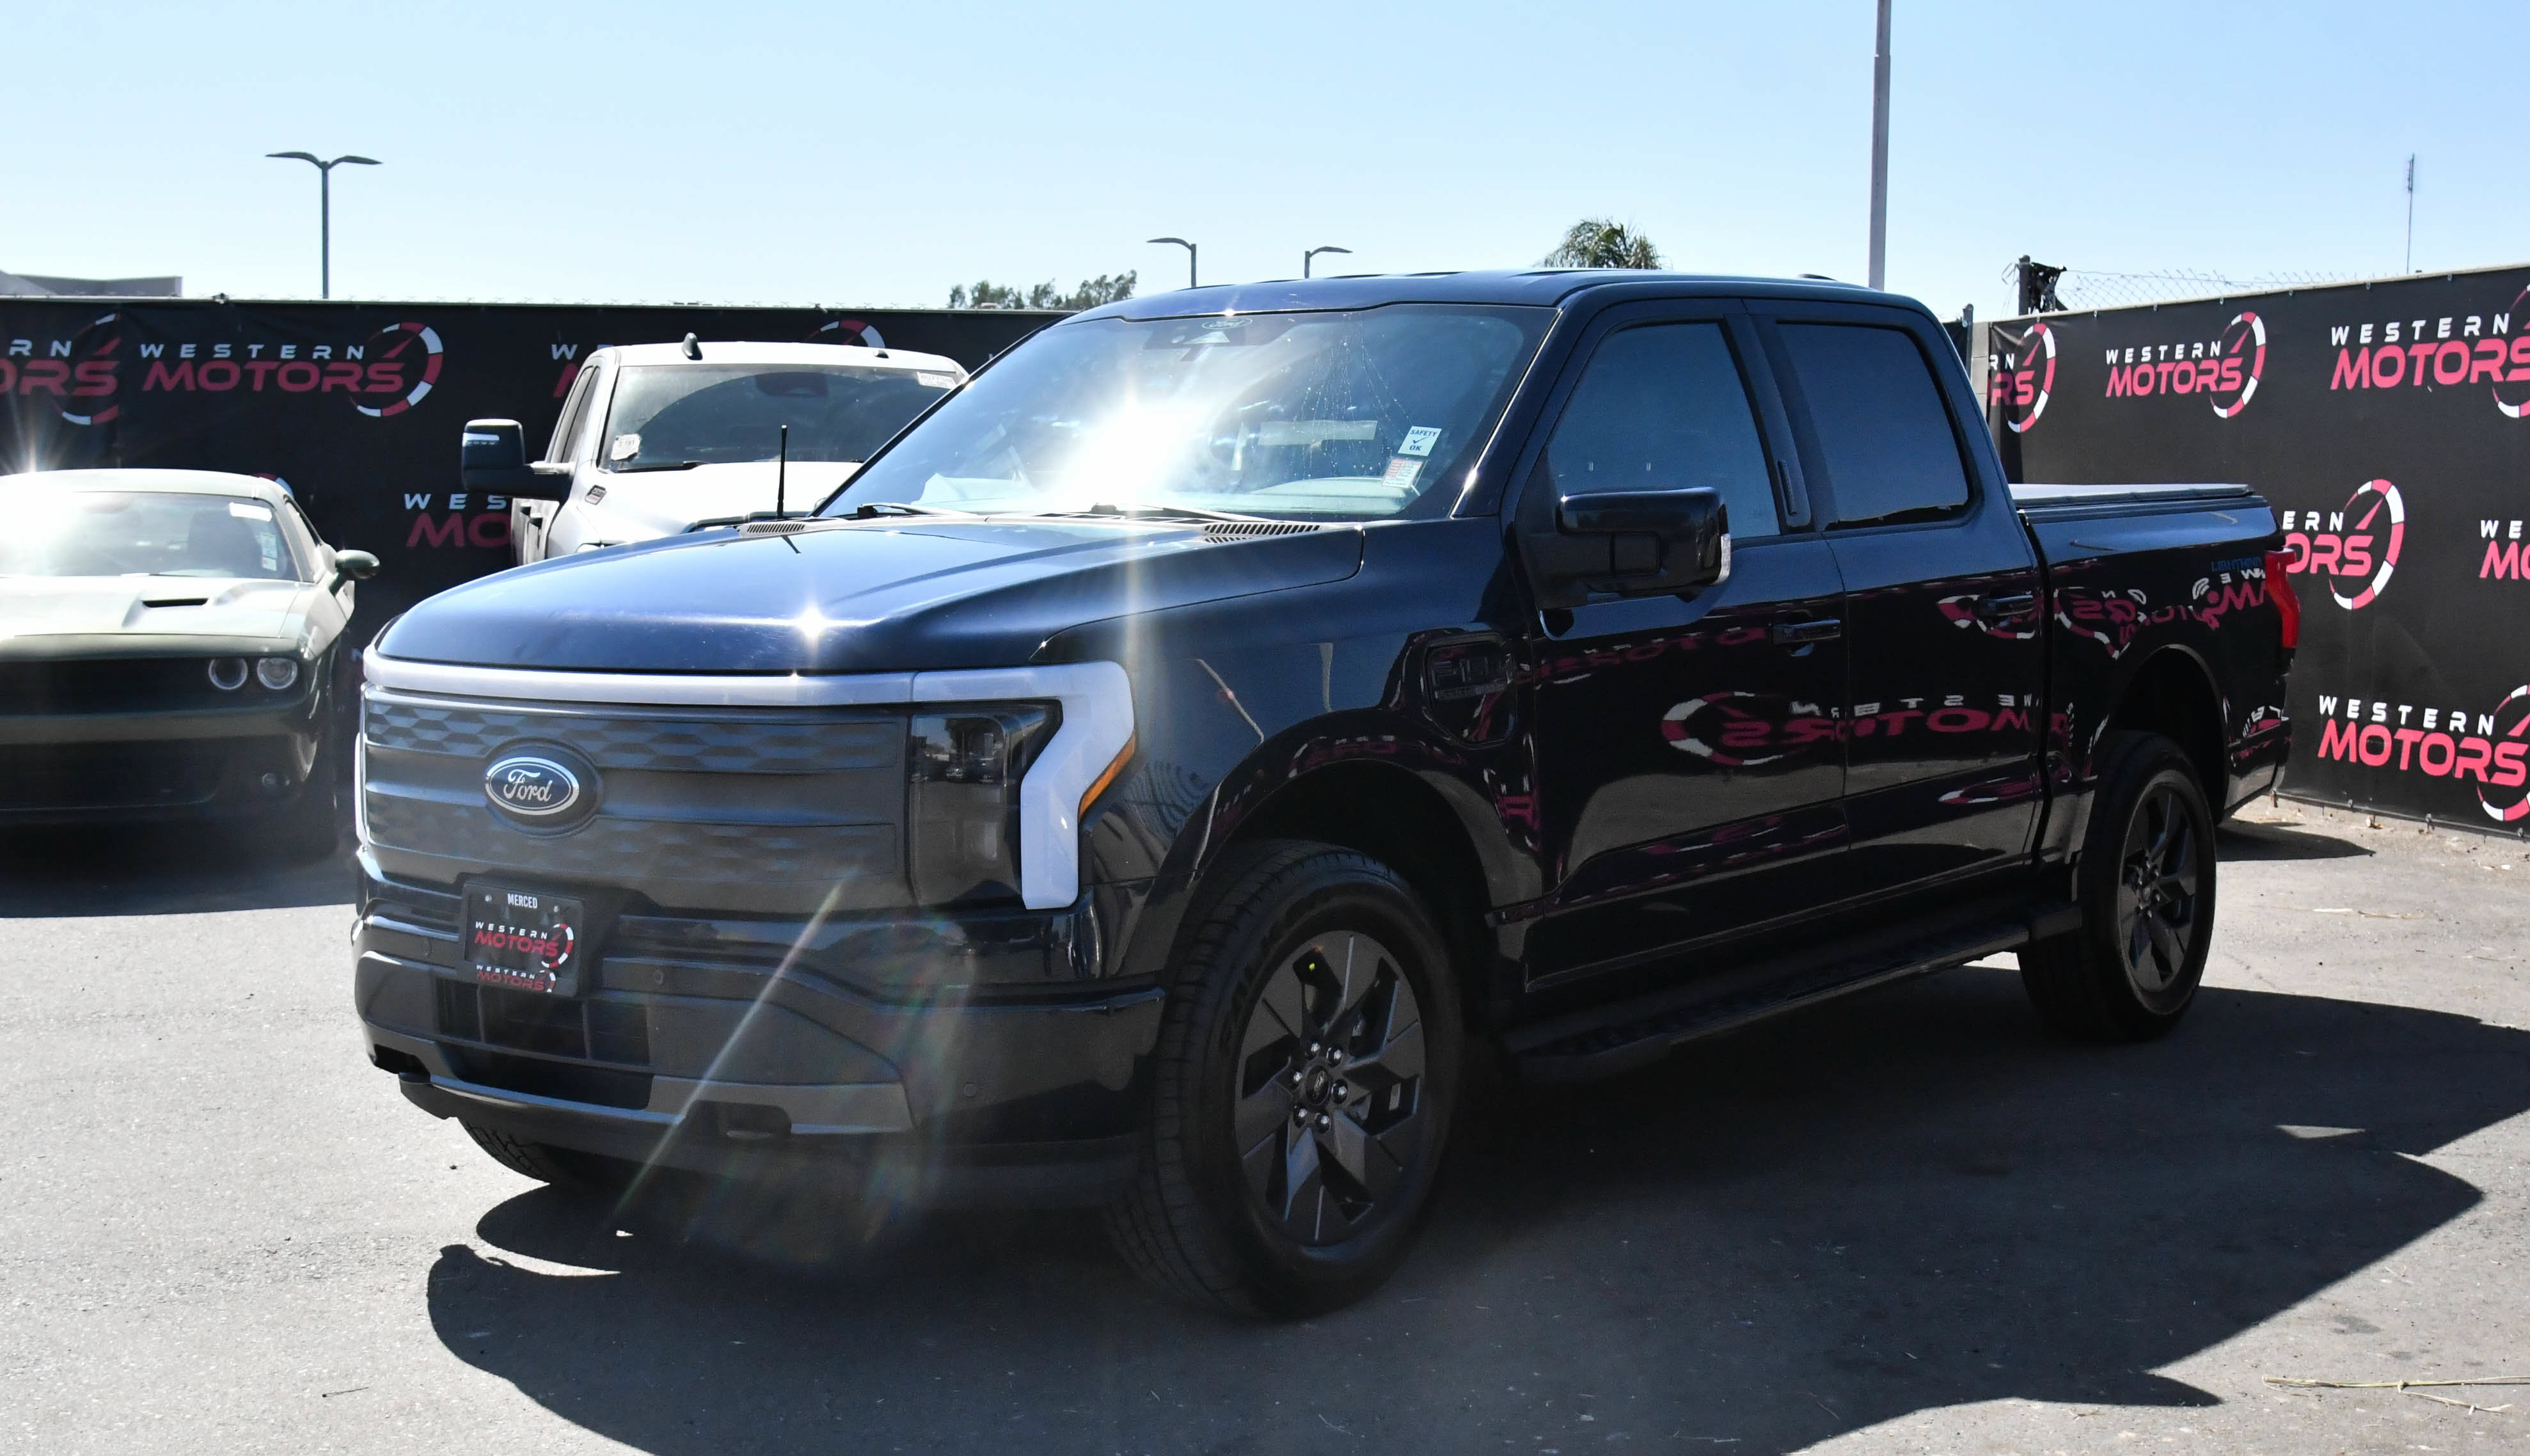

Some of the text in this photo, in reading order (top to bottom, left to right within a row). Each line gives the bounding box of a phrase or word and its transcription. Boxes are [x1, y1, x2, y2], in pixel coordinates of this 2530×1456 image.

[2330, 313, 2510, 347] WESTERN
[9, 339, 72, 357] RN
[140, 344, 365, 360] WESTERN
[2106, 340, 2221, 365] WESTERN
[1988, 353, 2014, 370] RN
[2330, 335, 2530, 390] MOTORS
[143, 360, 405, 393] MOTORS
[1988, 370, 2035, 406] RS
[2105, 357, 2243, 397] MOTORS
[404, 494, 507, 510] WES
[406, 512, 511, 548] MO
[2282, 511, 2344, 532] ERN
[2481, 520, 2523, 539] WE
[2479, 541, 2530, 580] M
[2319, 695, 2494, 736] WESTERN
[2318, 718, 2529, 787] MOTORS
[503, 768, 553, 802] Ford
[507, 893, 538, 908] MERCED
[475, 921, 548, 940] WESTERN
[475, 930, 558, 957] MOTORS
[477, 965, 535, 979] WESTERN
[477, 970, 544, 992] MOTORS
